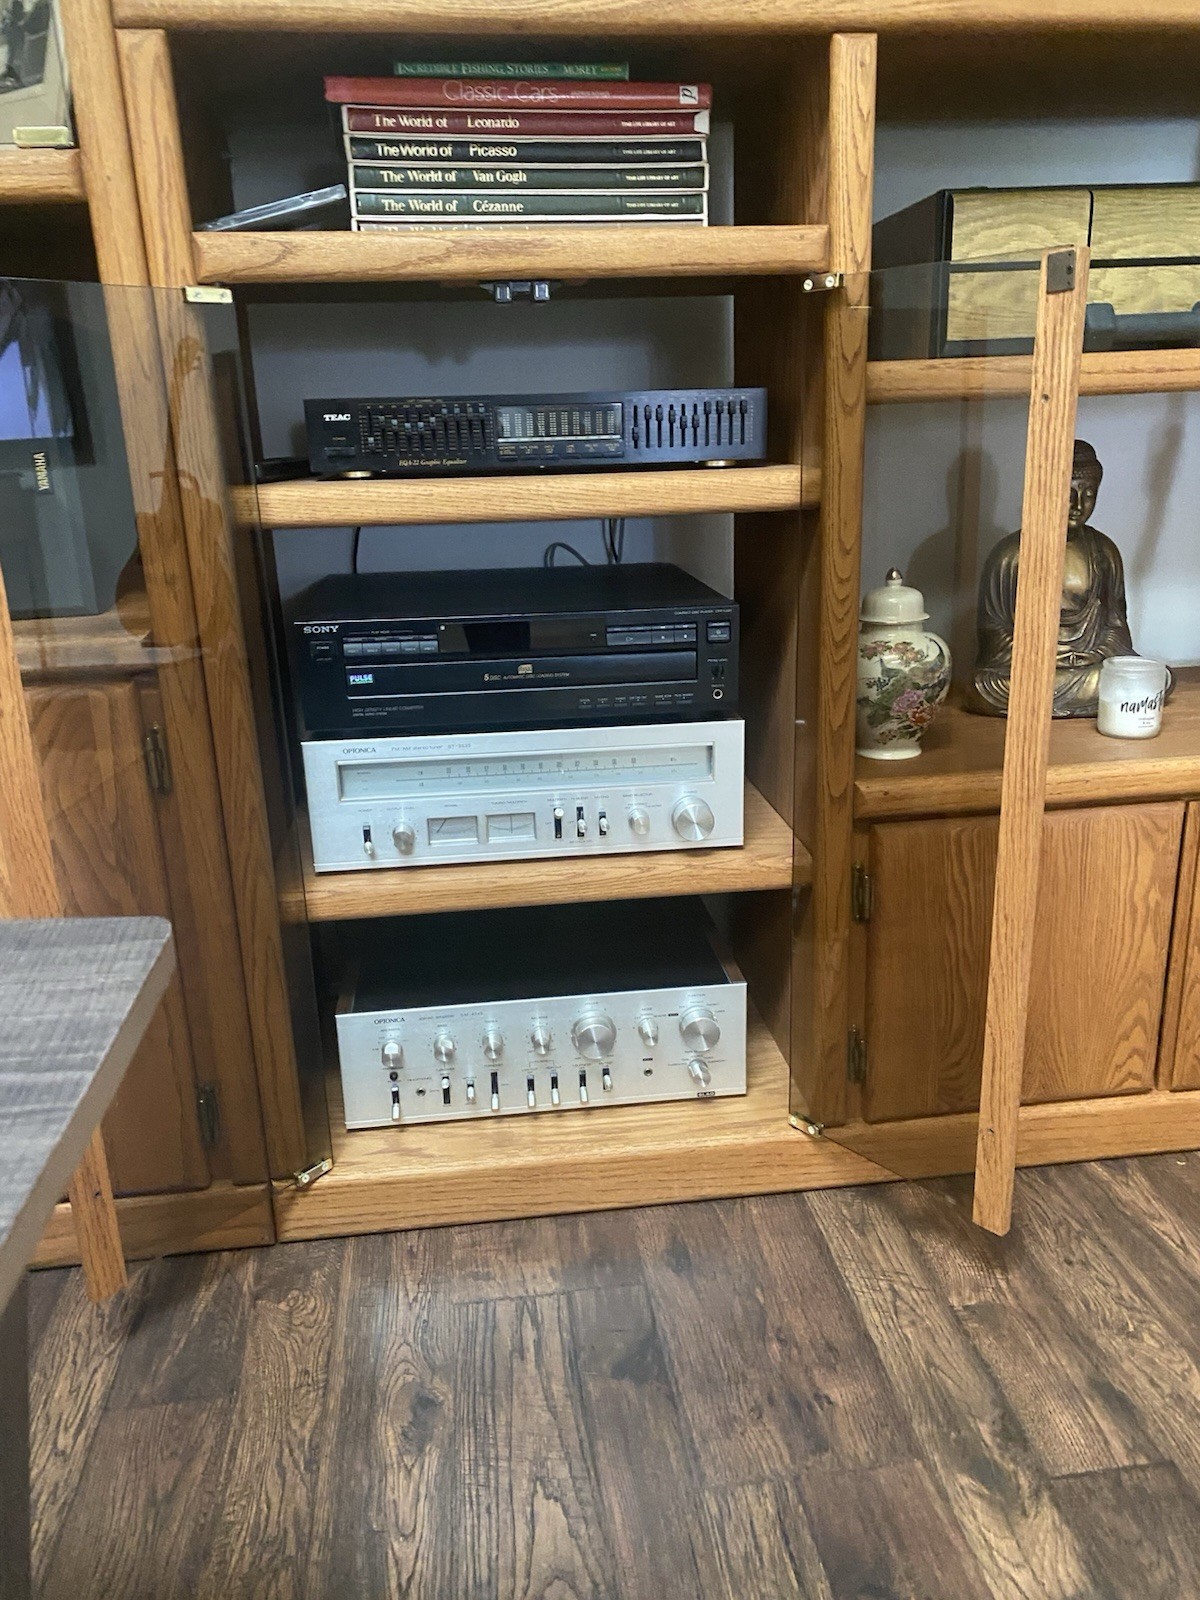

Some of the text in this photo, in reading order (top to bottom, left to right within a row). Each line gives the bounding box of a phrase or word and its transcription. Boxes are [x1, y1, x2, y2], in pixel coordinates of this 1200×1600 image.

[461, 63, 505, 75] FISHING
[506, 63, 549, 75] STORIES
[442, 79, 559, 103] Classic Cars
[374, 114, 520, 129] The World of Leonardo
[375, 143, 518, 157] The World of Picasso
[380, 169, 528, 186] The World of Van Gogh
[381, 198, 525, 213] The World of Cézanne
[323, 413, 351, 423] TEAC
[33, 451, 50, 491] YAMAHA
[303, 625, 339, 634] SONY
[349, 673, 373, 682] PULSE
